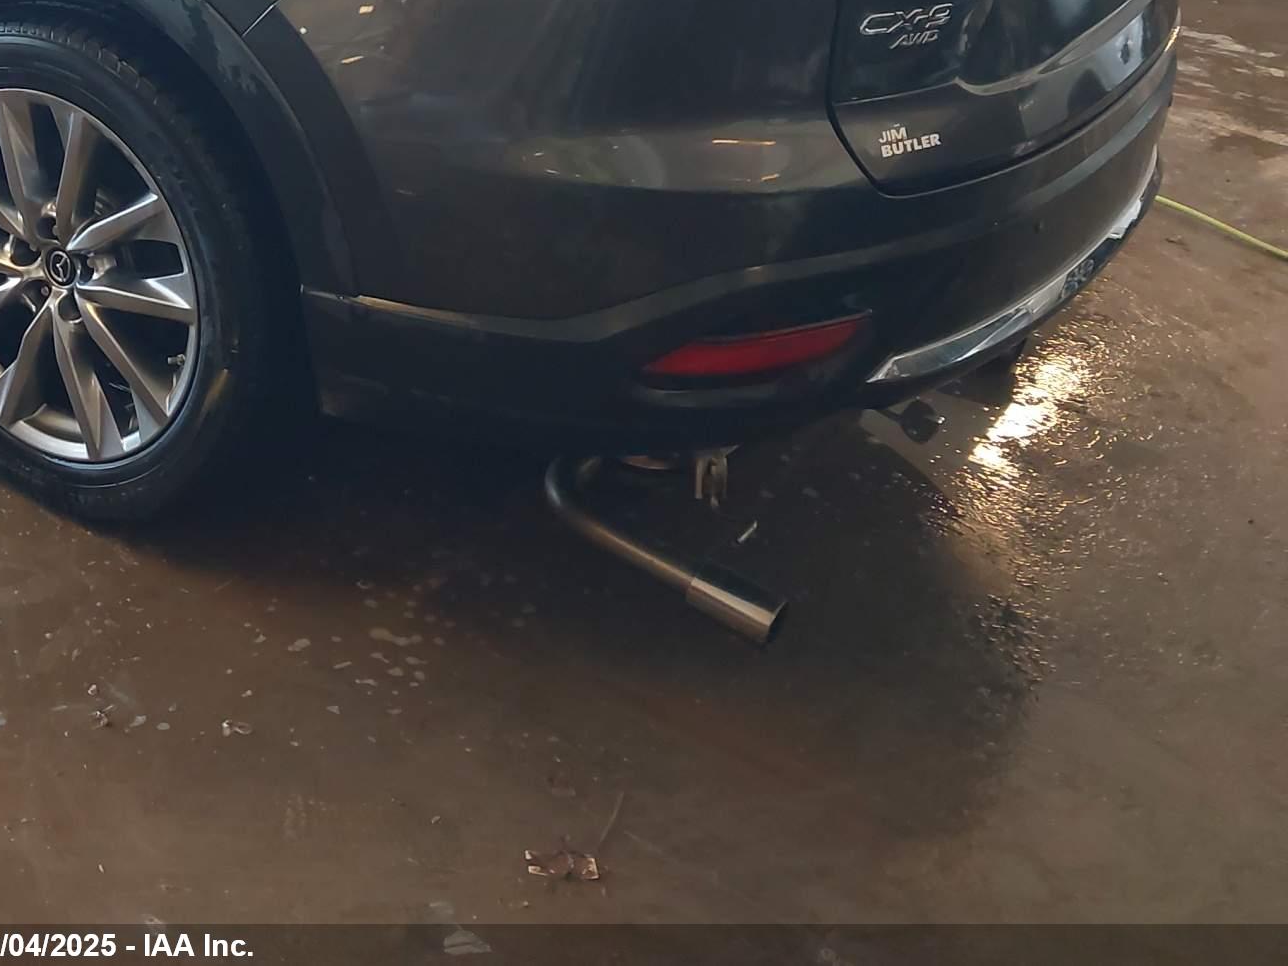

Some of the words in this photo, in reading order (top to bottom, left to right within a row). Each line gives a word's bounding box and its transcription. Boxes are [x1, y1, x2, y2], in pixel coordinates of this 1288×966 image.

[860, 3, 953, 35] CX-9
[889, 29, 940, 49] AWD
[878, 126, 908, 144] JIM
[881, 133, 941, 158] BUTLER
